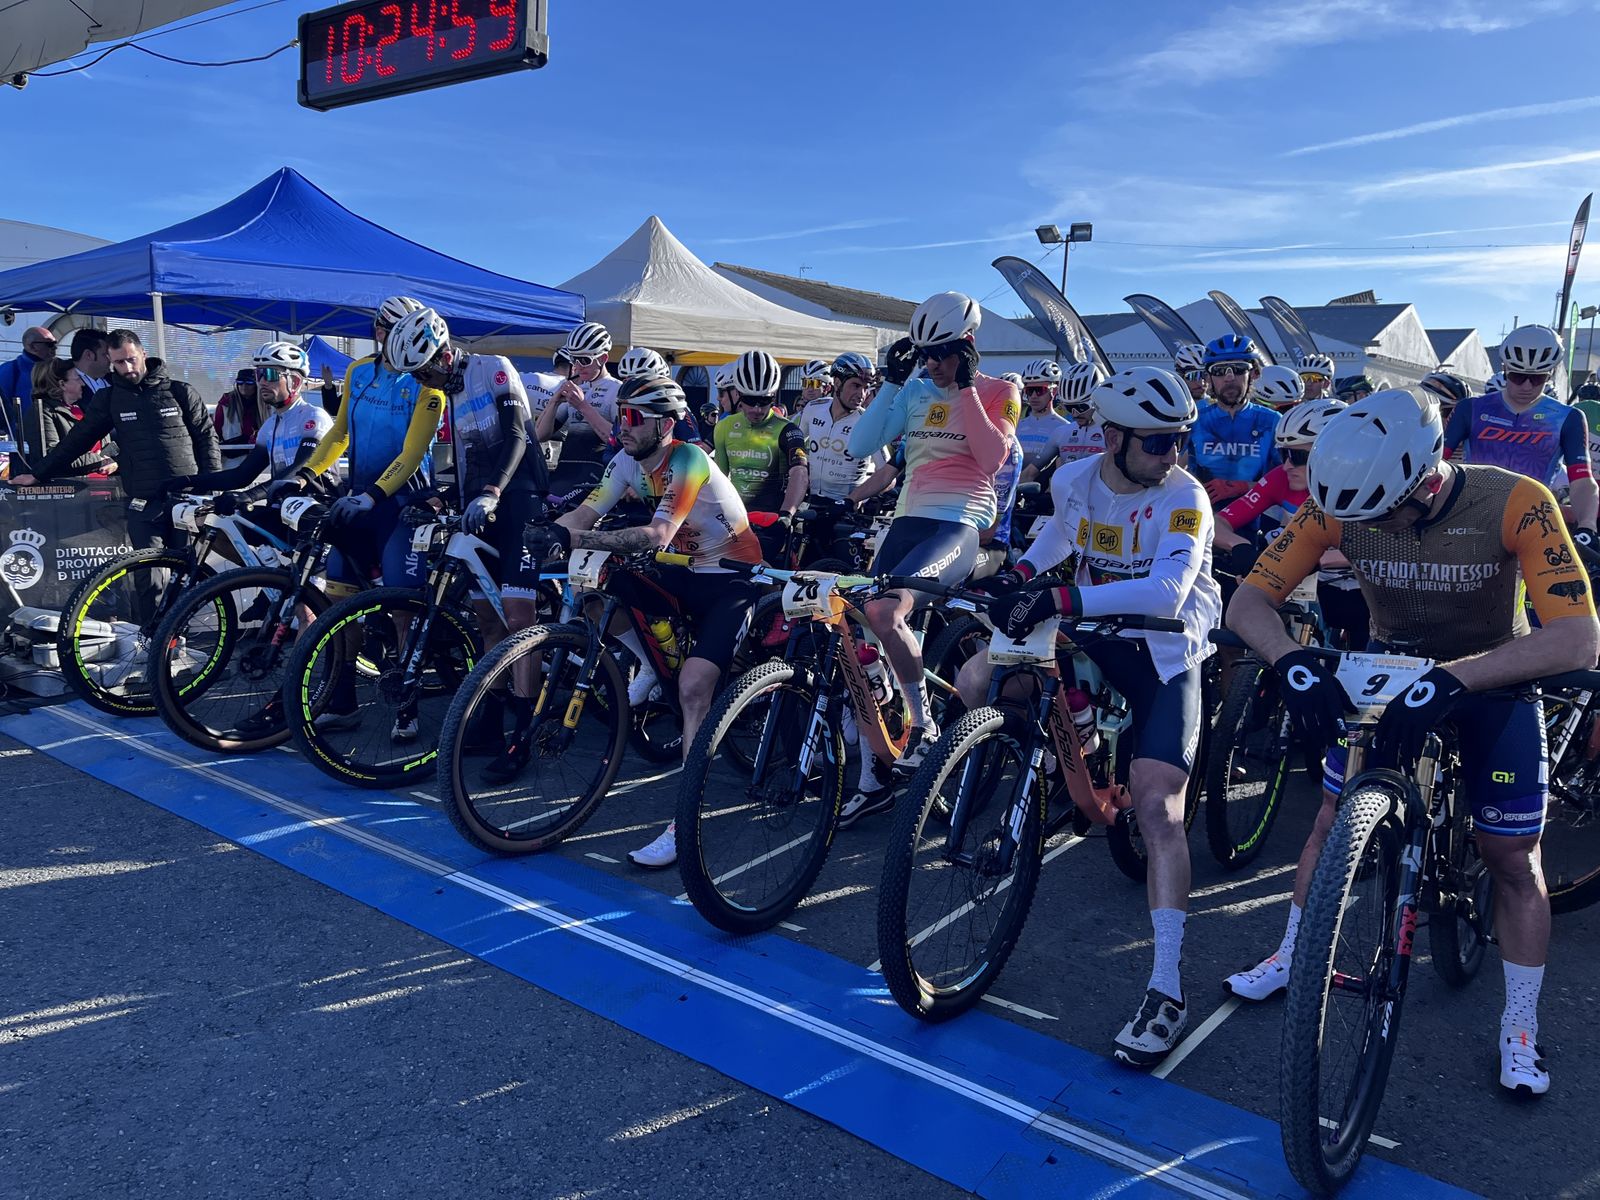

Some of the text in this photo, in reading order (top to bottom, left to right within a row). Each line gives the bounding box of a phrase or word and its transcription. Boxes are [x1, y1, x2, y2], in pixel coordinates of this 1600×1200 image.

[326, 0, 517, 84] 10:24:59
[812, 417, 825, 427] BH
[1477, 426, 1552, 445] DMT
[286, 501, 304, 514] 49
[1176, 514, 1198, 530] Buff
[57, 558, 113, 569] PROVIN
[579, 551, 594, 570] 3
[1386, 579, 1410, 590] RACE
[1415, 581, 1451, 592] HUELVA
[1456, 580, 1482, 592] 2024
[1361, 673, 1390, 697] 9
[315, 746, 364, 779] SCORPION
